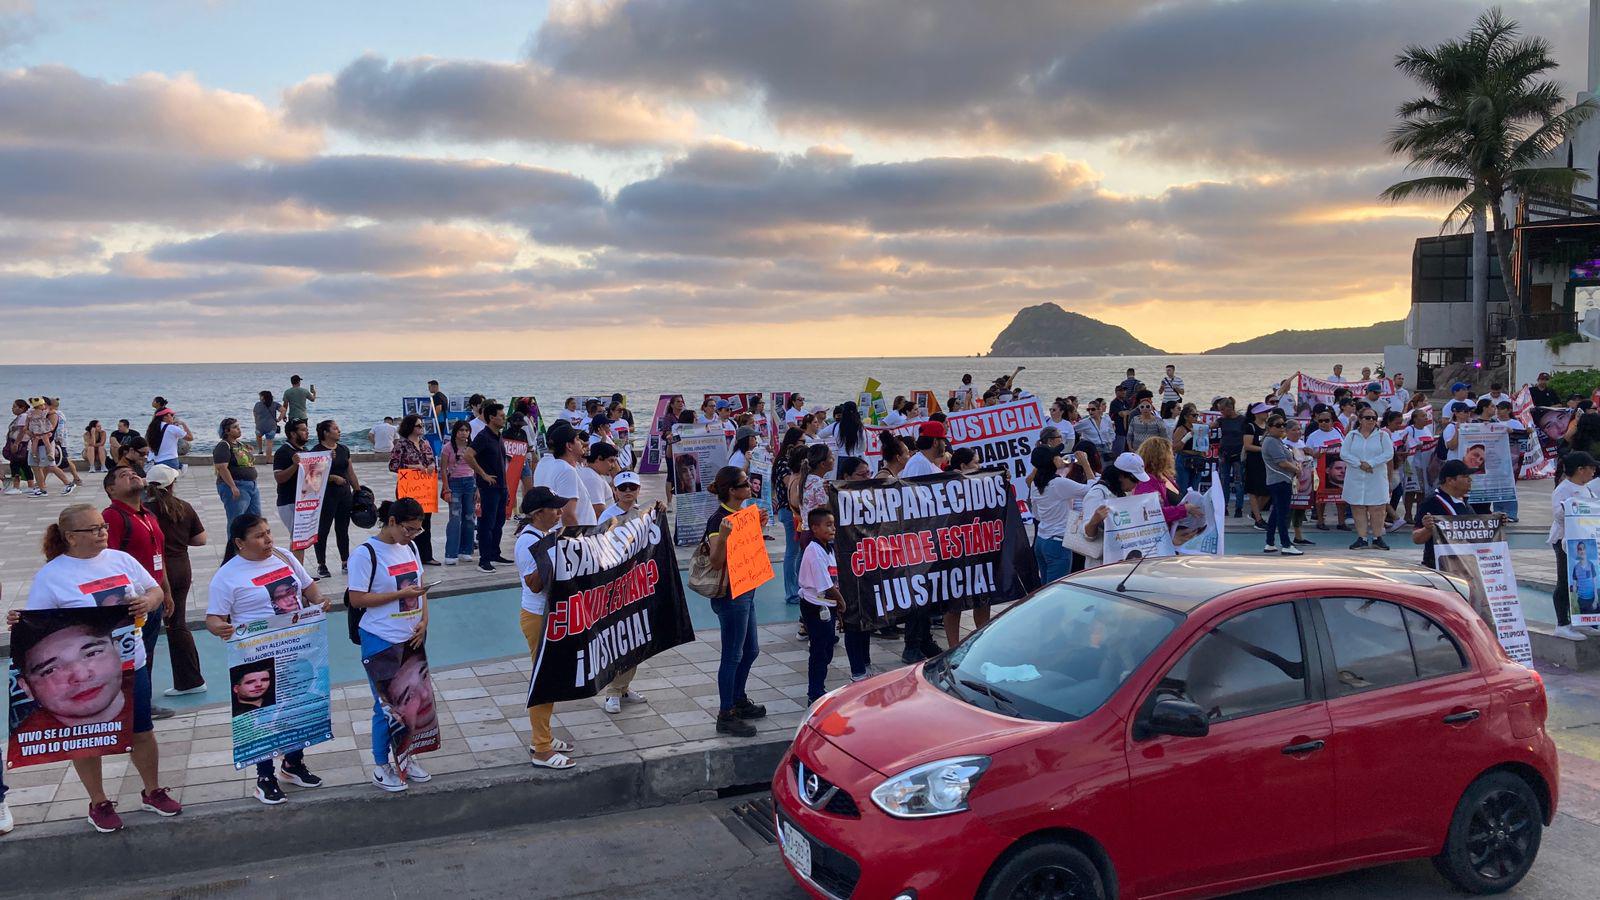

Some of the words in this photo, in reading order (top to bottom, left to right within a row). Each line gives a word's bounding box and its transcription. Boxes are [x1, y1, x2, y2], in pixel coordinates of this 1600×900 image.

[949, 405, 1040, 442] USTICIA
[837, 475, 1007, 526] DESAPARECIDOS
[1438, 520, 1451, 530] SE
[1452, 520, 1485, 529] BUSCA
[1487, 519, 1500, 529] SU
[1446, 529, 1494, 540] PARADERO
[851, 530, 938, 577] ¿DONDE
[937, 517, 1005, 560] ESTÁN?
[873, 562, 997, 617] ¡JUSTICIA!
[243, 651, 275, 663] VILLALOBOS
[275, 643, 311, 656] BUSTAMANTE
[255, 644, 268, 653] NERY
[269, 638, 301, 649] ALEJANDRO
[575, 608, 652, 687] ¡JUSTICIA!
[18, 729, 42, 744] VIVO
[44, 728, 57, 740] SE
[58, 727, 71, 738] LO
[72, 721, 122, 736] LLEVARON
[21, 742, 46, 757] VIVO
[48, 741, 60, 753] LO
[62, 735, 118, 751] QUEREMOS
